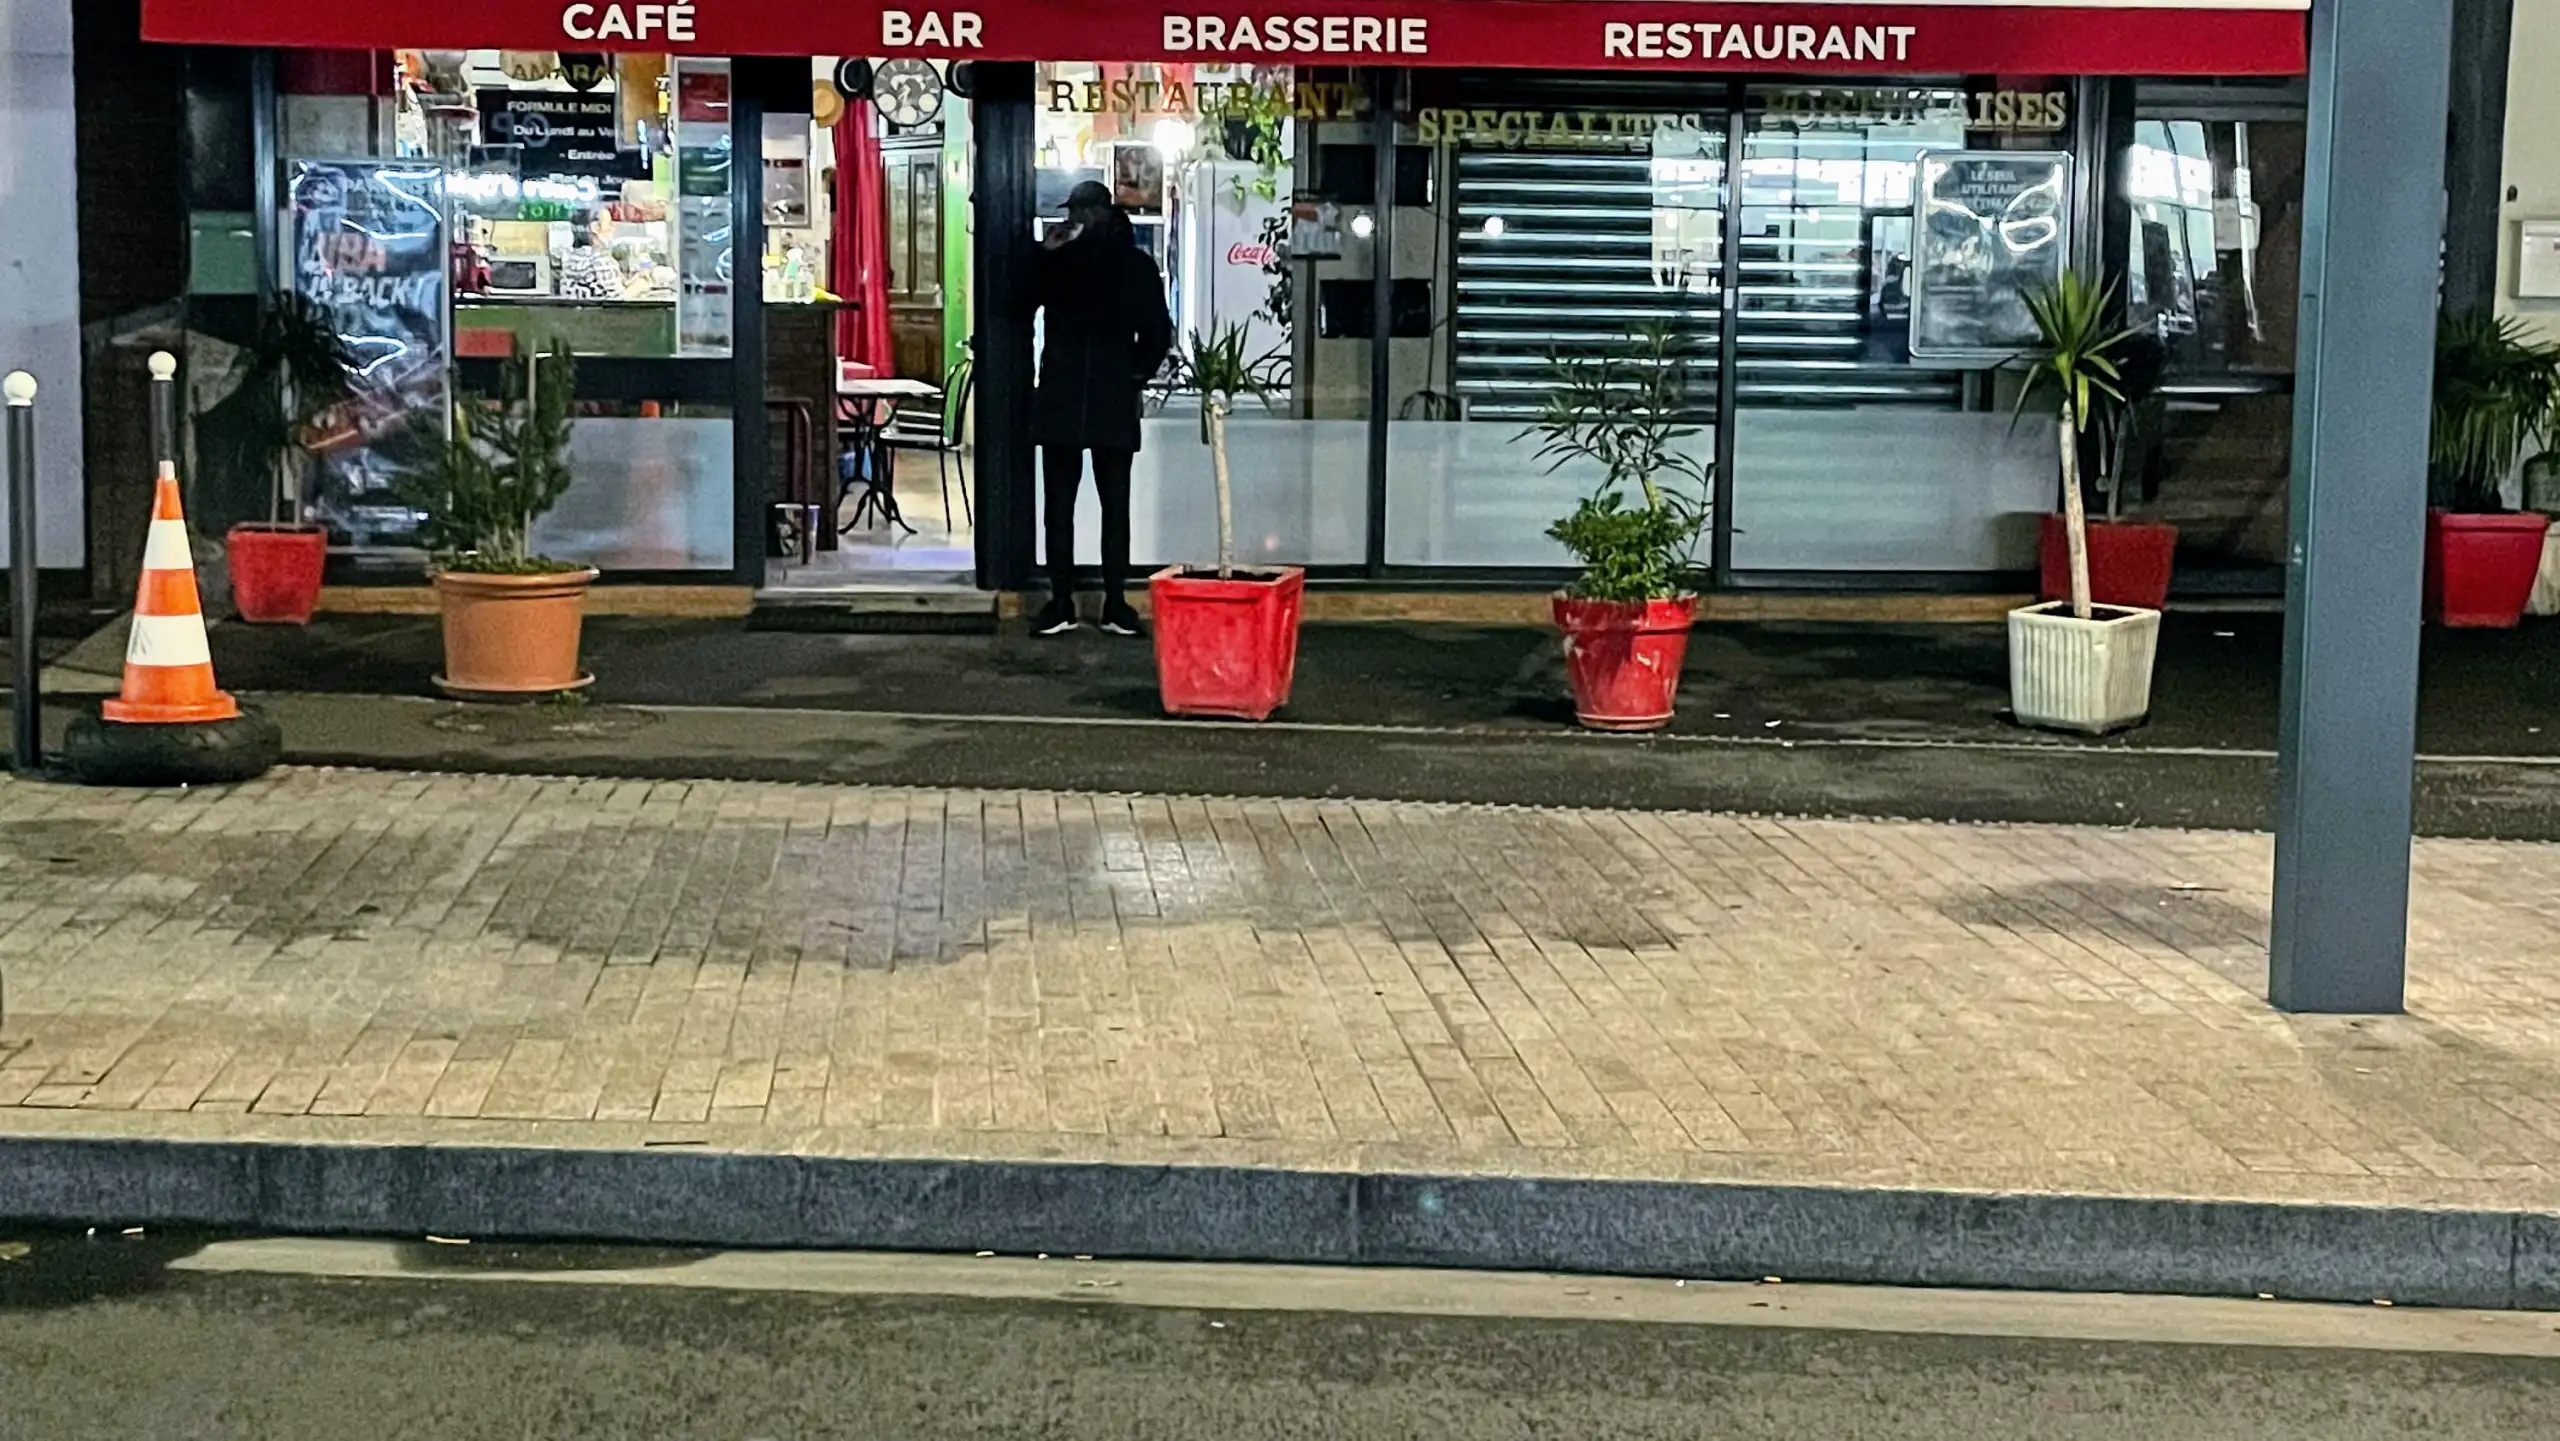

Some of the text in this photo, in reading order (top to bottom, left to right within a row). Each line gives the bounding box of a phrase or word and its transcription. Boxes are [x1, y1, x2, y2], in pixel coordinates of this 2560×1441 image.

[562, 0, 1916, 61] CAFÉ BAR BRASSERIE RESTAURANT
[507, 101, 611, 113] FORMULE MIDI
[1047, 79, 1359, 117] RESTAURANT
[577, 128, 595, 137] au
